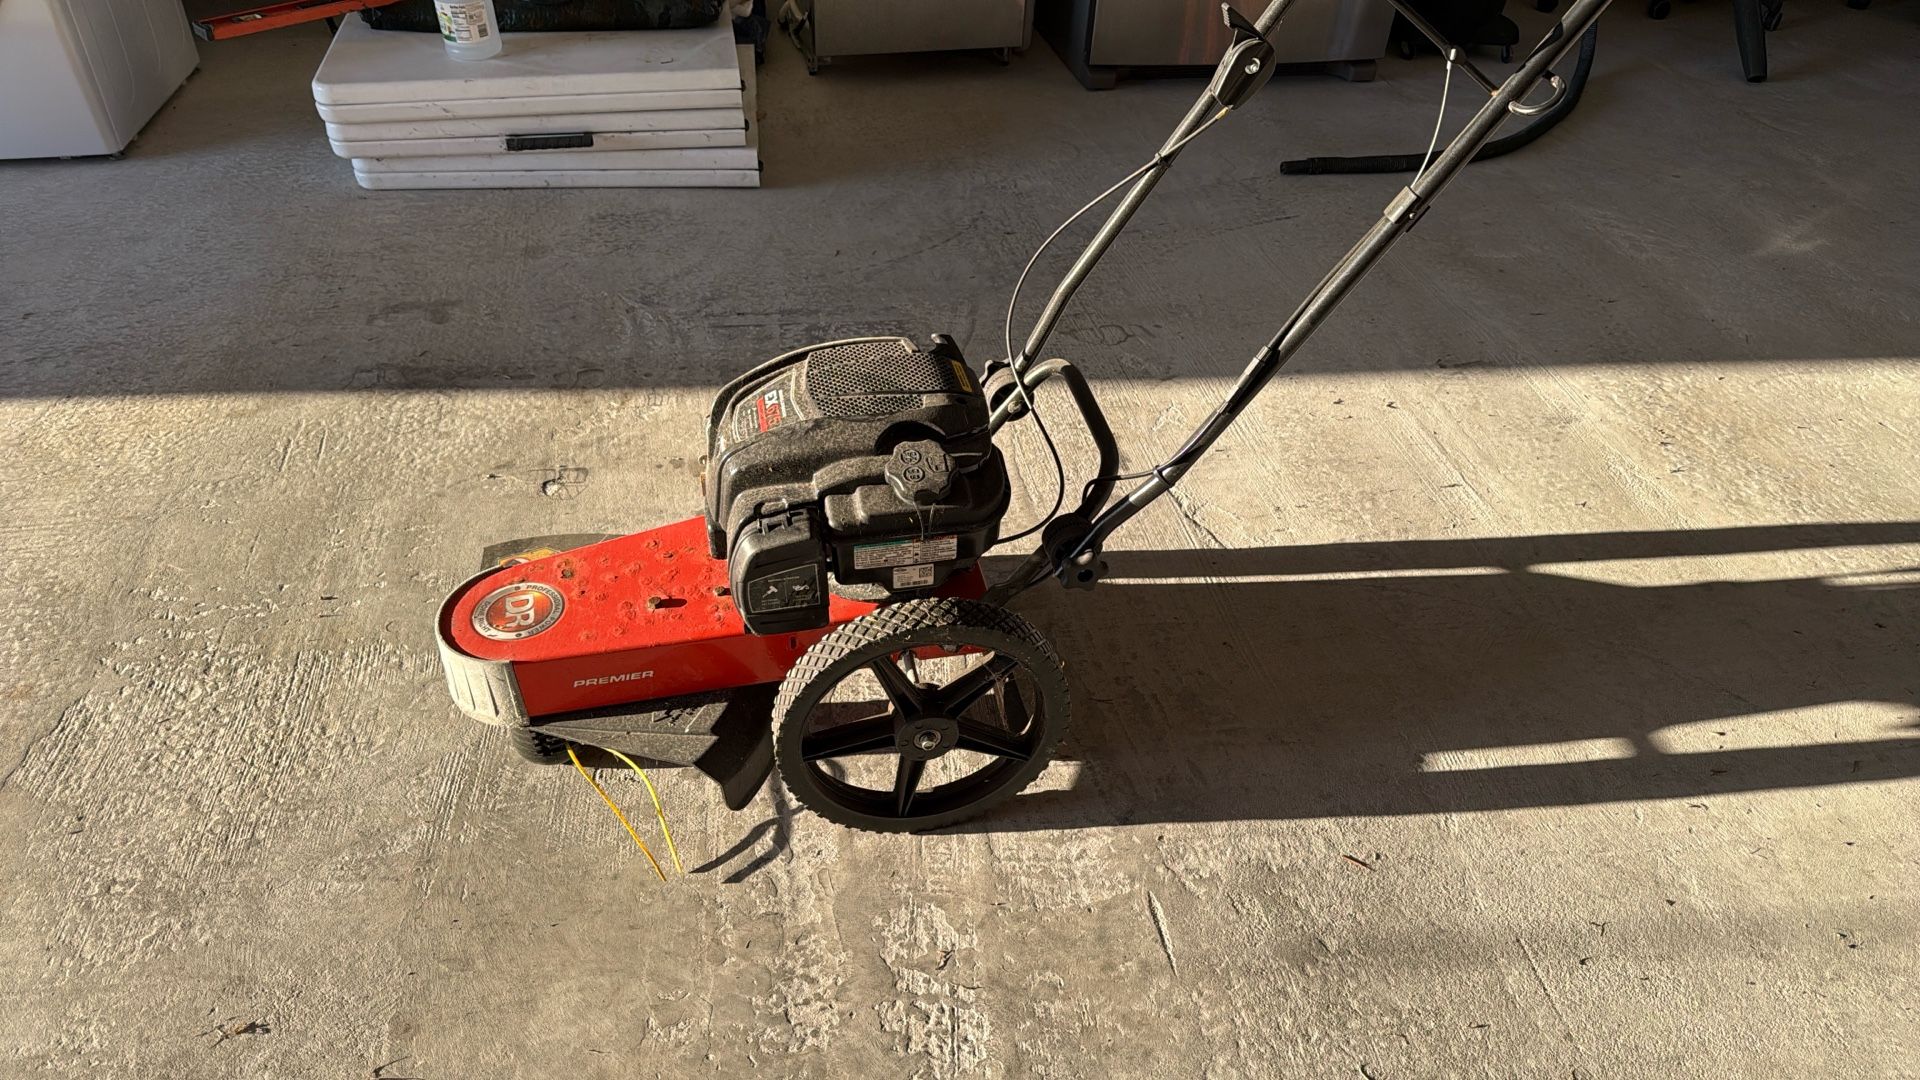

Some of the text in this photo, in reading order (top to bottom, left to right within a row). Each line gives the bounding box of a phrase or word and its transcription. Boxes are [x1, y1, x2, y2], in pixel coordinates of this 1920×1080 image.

[504, 593, 535, 628] DR
[526, 584, 562, 614] PROFESSIONAL
[573, 670, 655, 689] PREMIER
